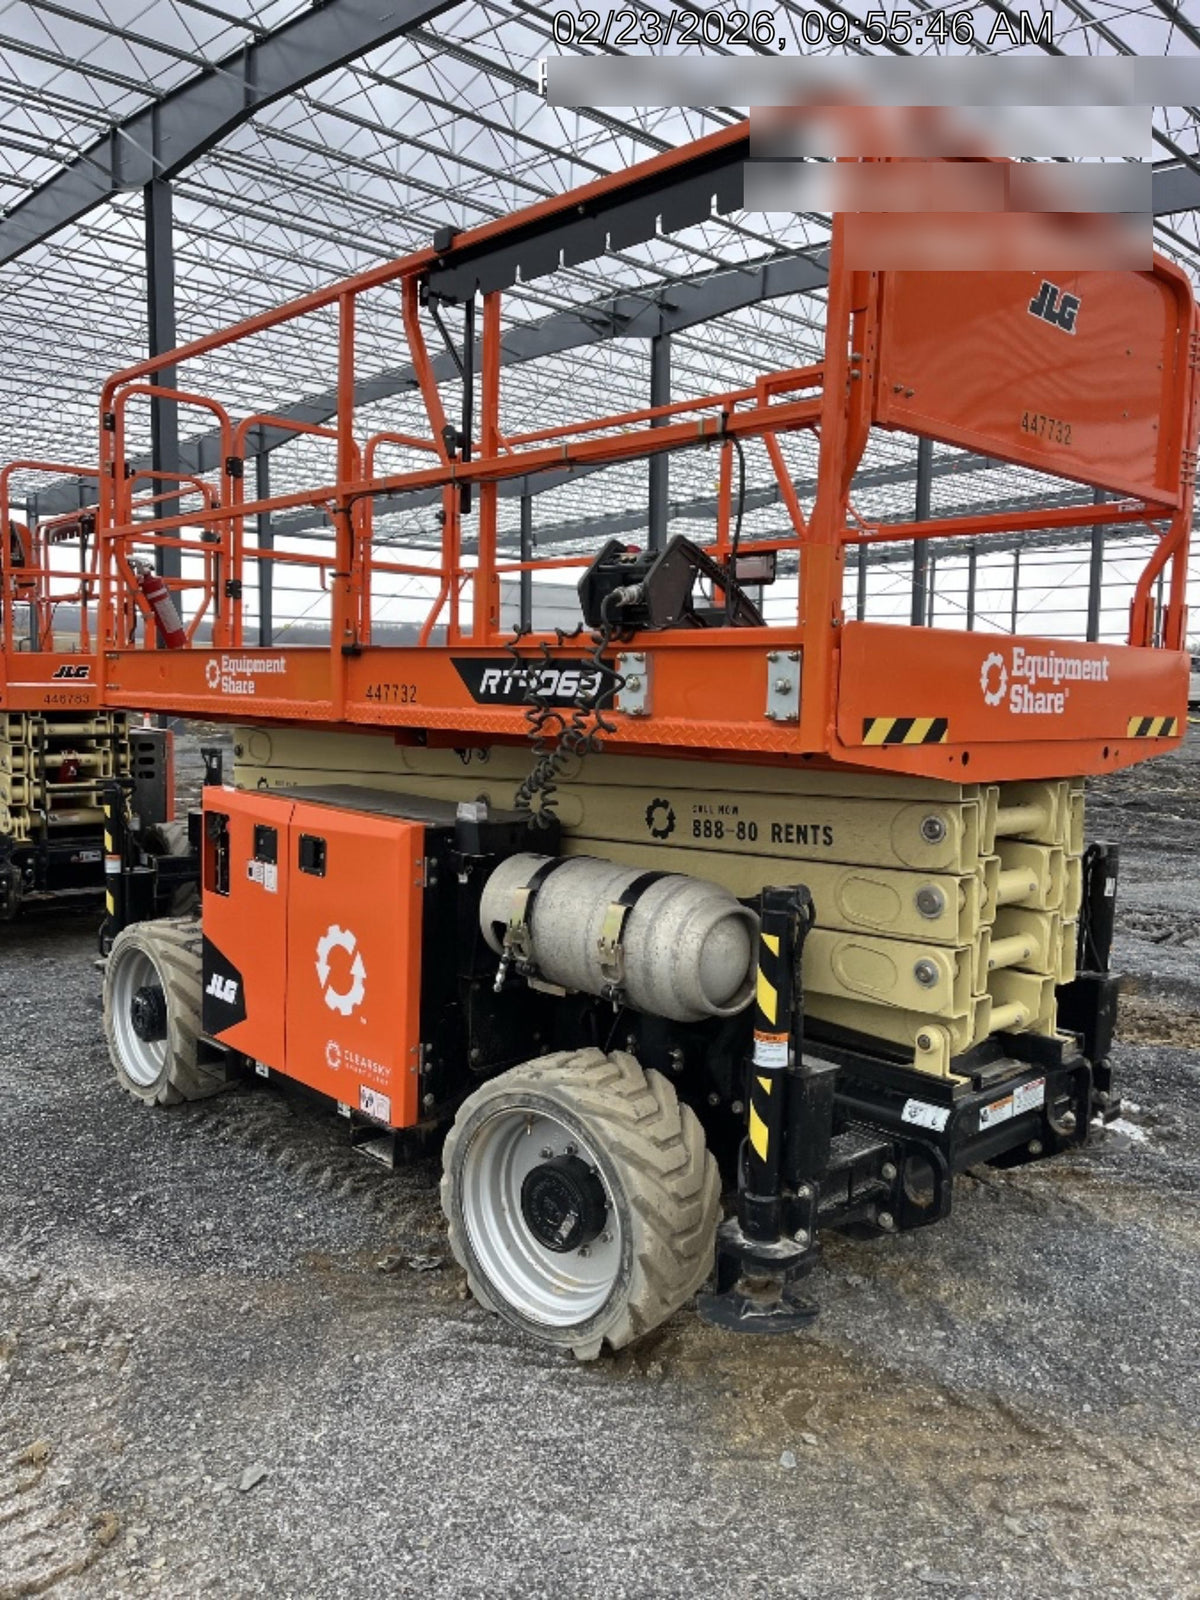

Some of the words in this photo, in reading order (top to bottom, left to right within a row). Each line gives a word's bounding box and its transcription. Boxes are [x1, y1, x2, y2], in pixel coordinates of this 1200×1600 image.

[1028, 279, 1082, 335] JLG
[1021, 411, 1072, 445] 447732
[52, 664, 91, 680] JLG
[221, 654, 287, 677] Equipment
[1011, 646, 1110, 685] Equipment
[221, 675, 255, 695] Share
[365, 683, 418, 704] 447732
[1009, 683, 1065, 714] Share
[692, 818, 759, 842] 888-80
[771, 822, 834, 846] RENTS
[205, 972, 239, 1004] JLG
